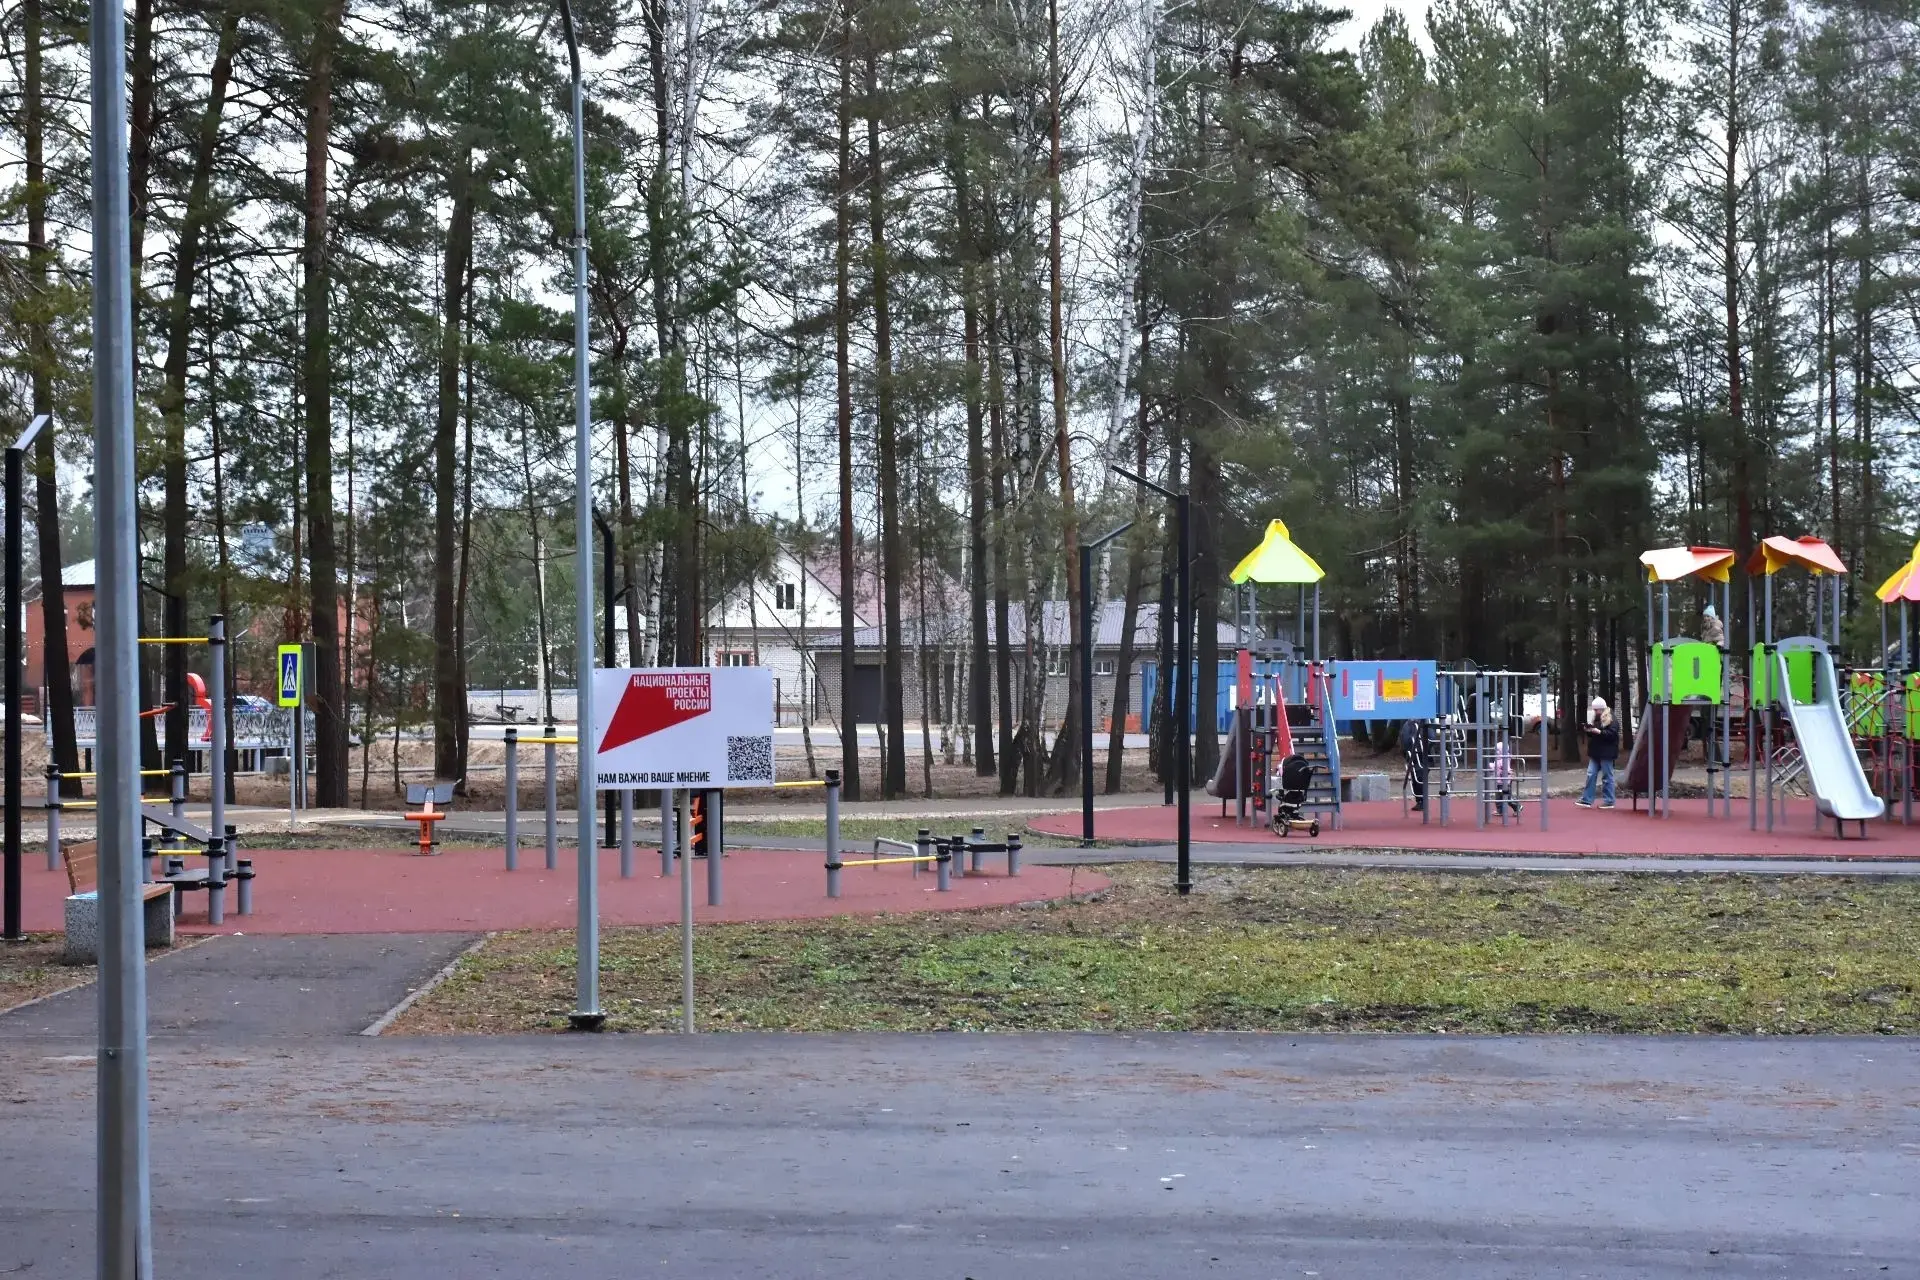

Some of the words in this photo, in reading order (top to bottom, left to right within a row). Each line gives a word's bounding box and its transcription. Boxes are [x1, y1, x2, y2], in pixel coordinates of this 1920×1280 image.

[633, 675, 709, 688] НАЦИОНАЛЬНЫЕ
[666, 687, 709, 698] ПРОЕКТЫ
[674, 698, 709, 710] РОССИИ
[597, 772, 617, 784] НАМ
[618, 772, 649, 784] ВАЖНО
[651, 772, 675, 783] ВАШЕ
[676, 771, 711, 783] МНЕНИЕ
